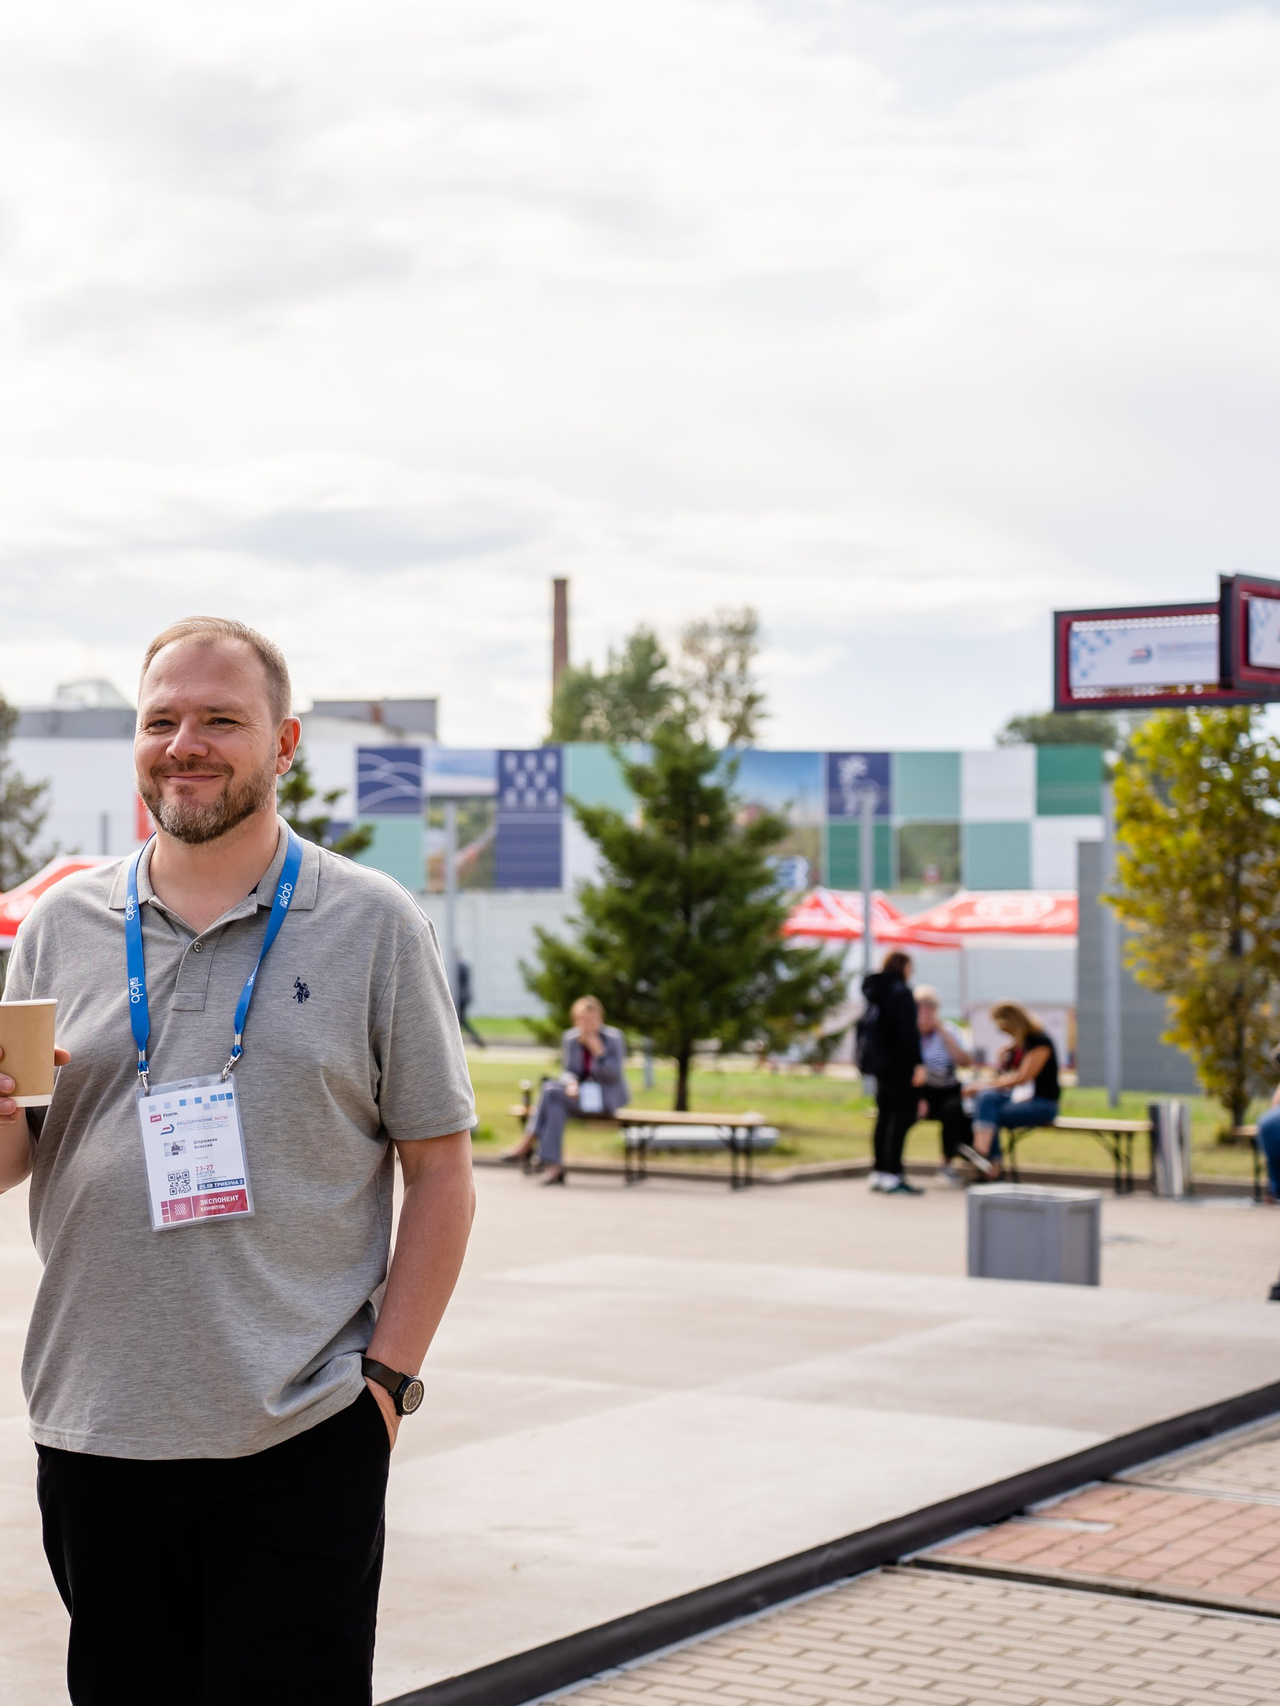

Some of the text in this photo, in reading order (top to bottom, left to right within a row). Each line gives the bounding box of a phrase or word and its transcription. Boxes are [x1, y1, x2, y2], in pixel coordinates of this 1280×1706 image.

[195, 1164, 214, 1172] 23-27
[214, 1180, 239, 1188] ТРИБУНА
[200, 1194, 239, 1206] ЭКСПОНЕНТ
